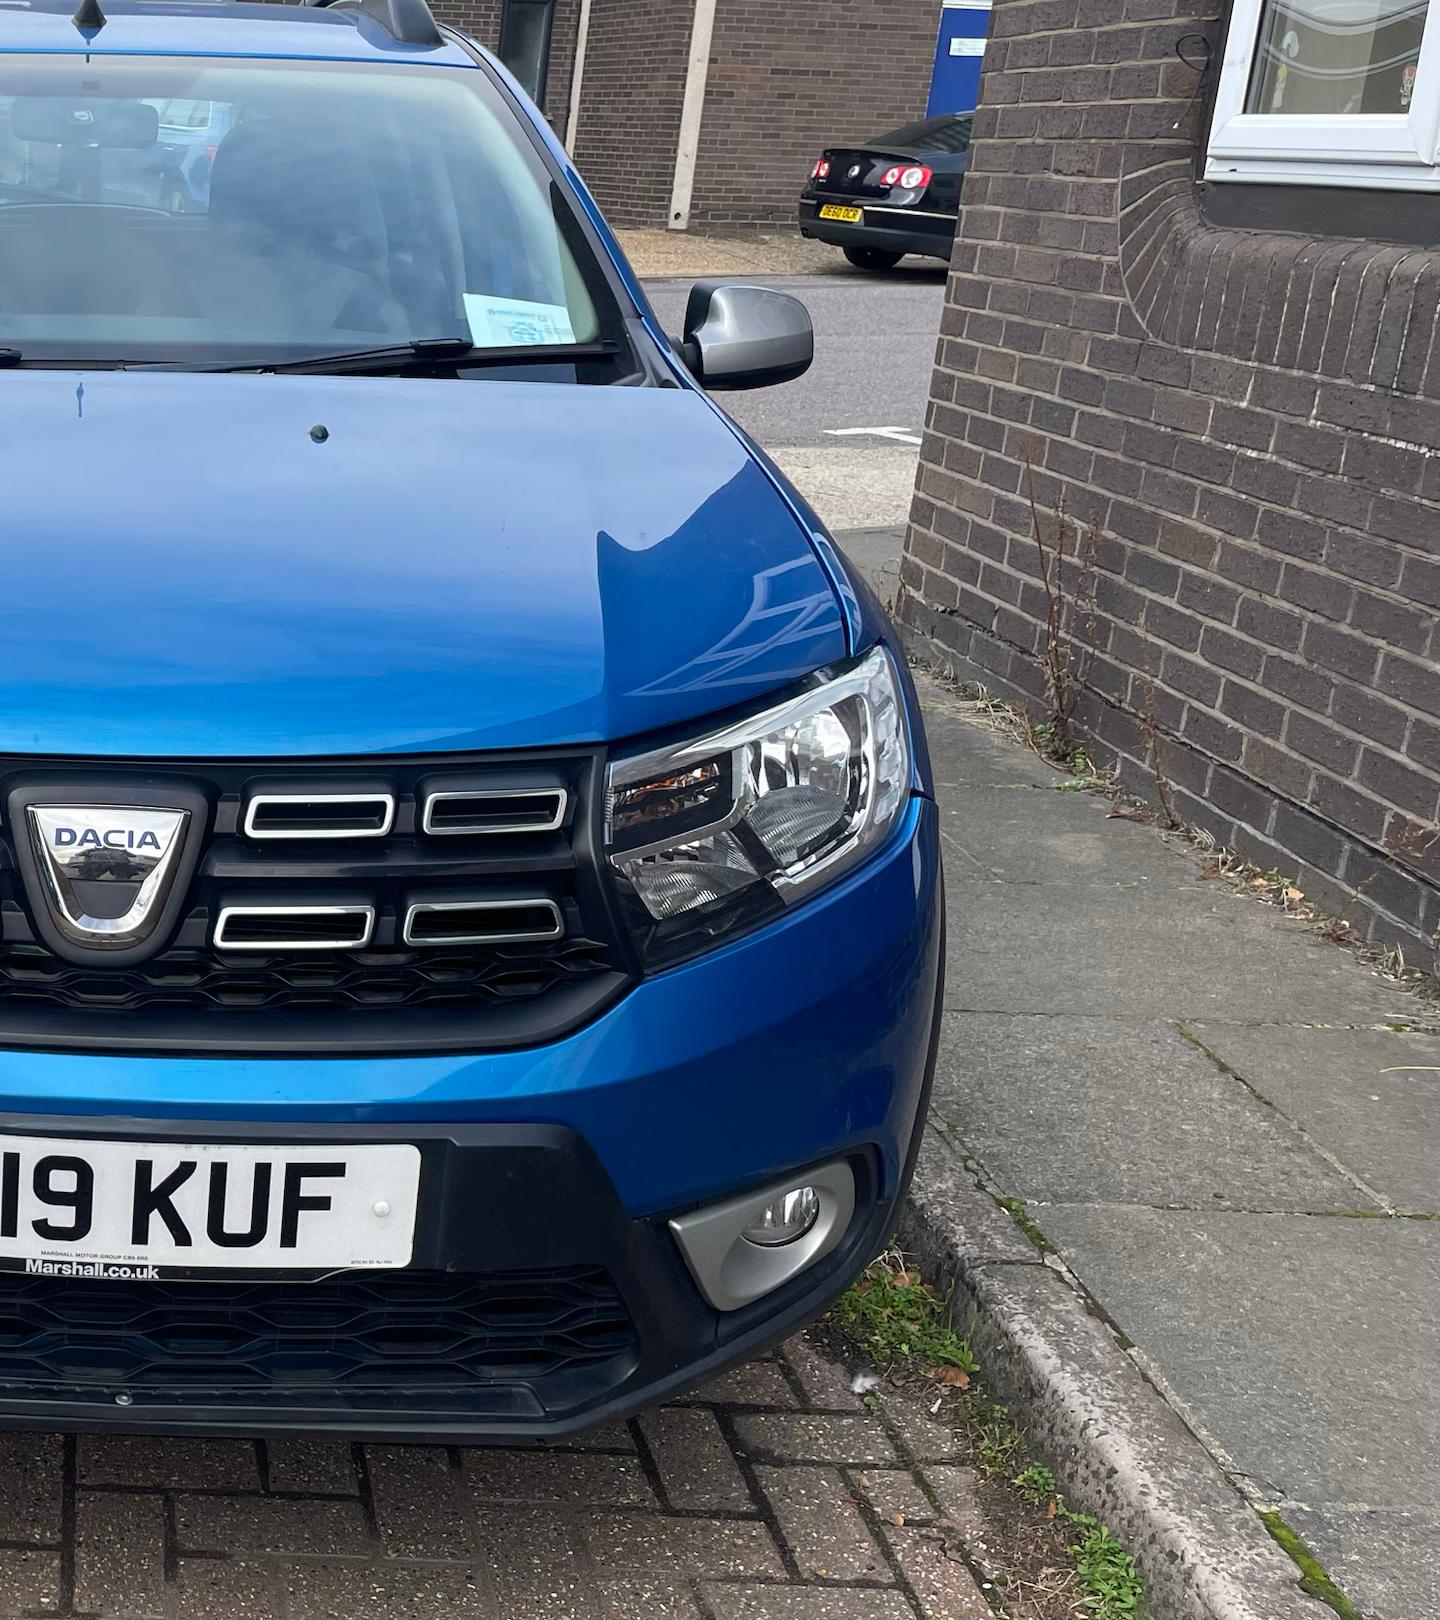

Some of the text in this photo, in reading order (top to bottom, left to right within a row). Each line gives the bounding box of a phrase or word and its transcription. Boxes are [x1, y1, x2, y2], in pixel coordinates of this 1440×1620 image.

[54, 827, 162, 850] DACIA
[131, 1159, 347, 1250] KUF
[40, 1250, 74, 1258] MARSHALL
[25, 1258, 160, 1279] Marshall.co.uk
